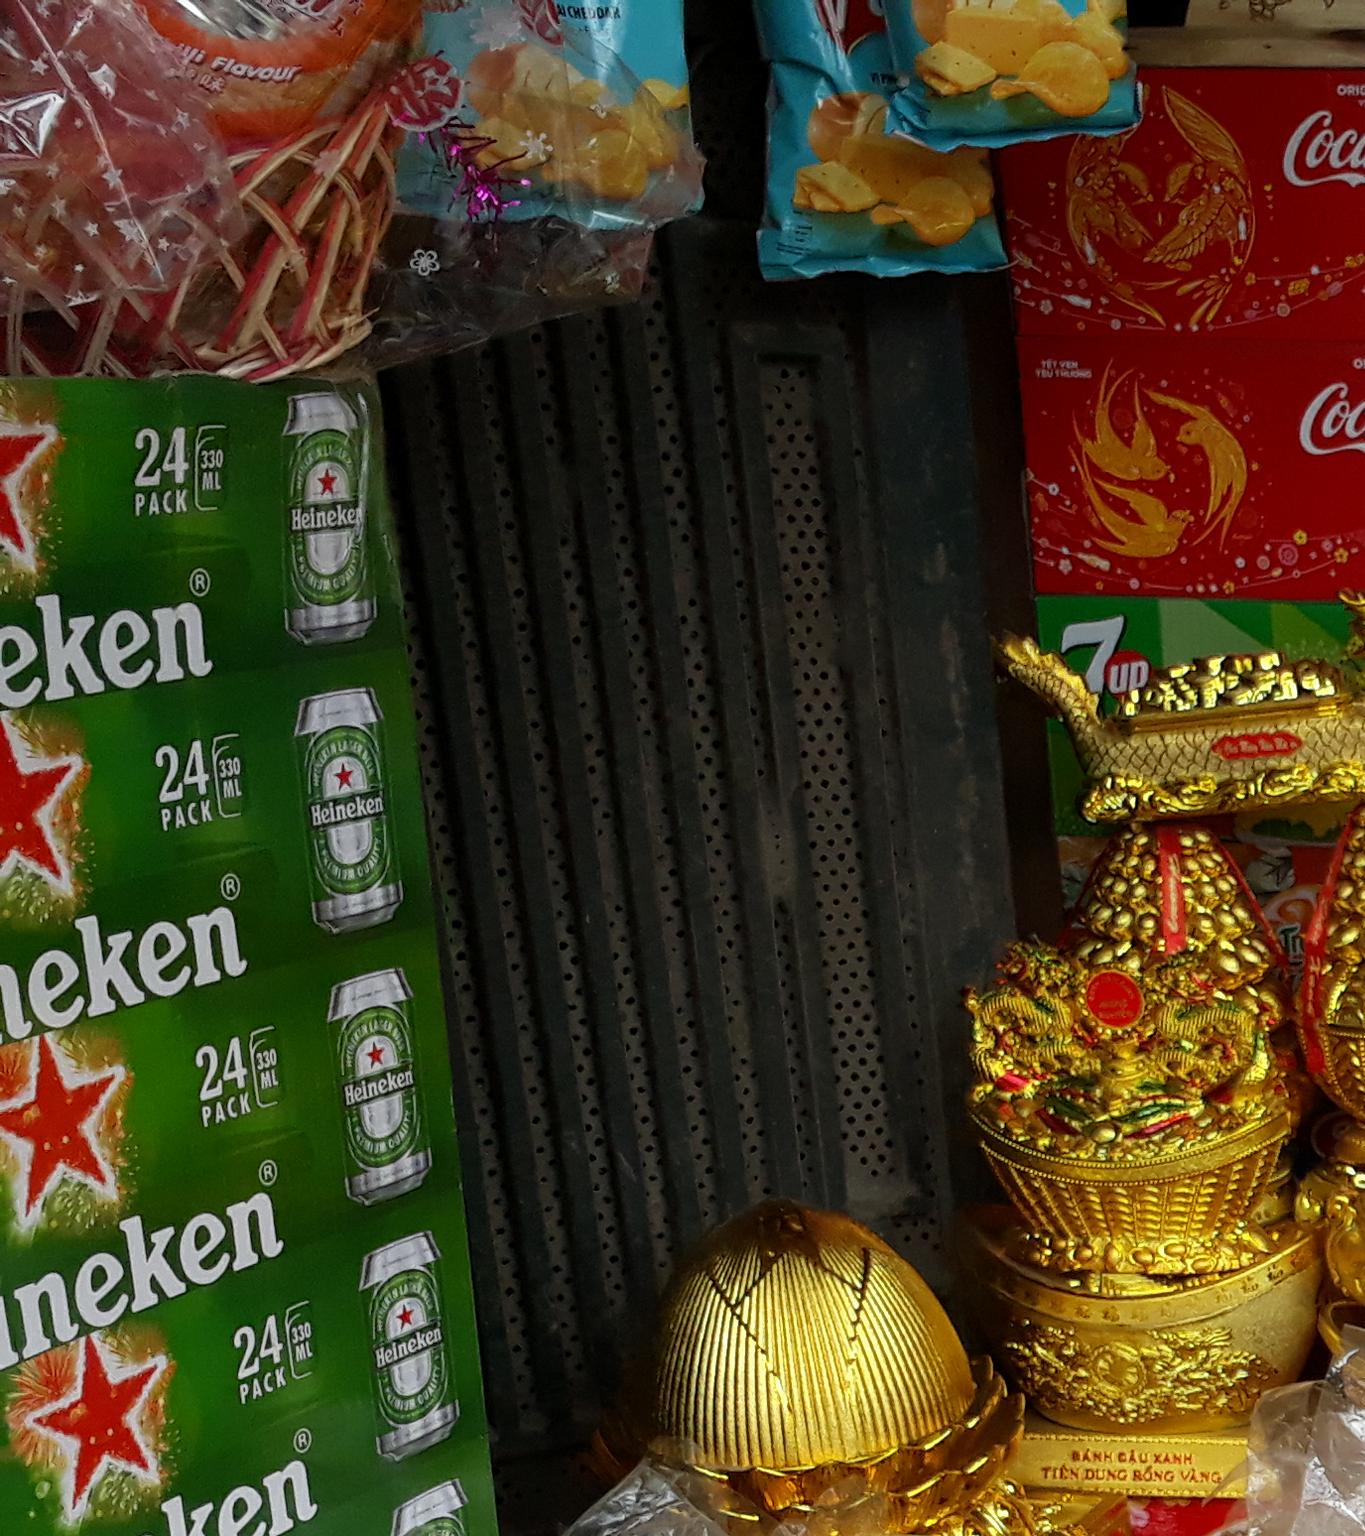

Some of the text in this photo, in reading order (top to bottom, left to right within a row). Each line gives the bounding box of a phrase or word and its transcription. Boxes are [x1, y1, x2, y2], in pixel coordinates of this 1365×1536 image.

[211, 56, 303, 83] Flavour
[134, 427, 189, 487] 24
[200, 448, 224, 469] 330
[202, 470, 222, 491] ML
[135, 491, 189, 516] PACK
[155, 740, 209, 803] 24
[219, 756, 241, 777] 330
[223, 778, 242, 798] ML
[161, 805, 213, 831] PACK
[311, 796, 384, 824] Heineken
[196, 1037, 247, 1101] 24
[256, 1048, 278, 1069] 330
[260, 1070, 279, 1089] ML
[344, 1070, 414, 1106] Heineken
[202, 1097, 252, 1128] PACK
[291, 1322, 312, 1344] 330
[233, 1315, 284, 1380] 24
[295, 1340, 313, 1362] ML
[375, 1327, 443, 1370] Heineken
[239, 1373, 287, 1405] PACK
[1153, 1453, 1193, 1465] XANH
